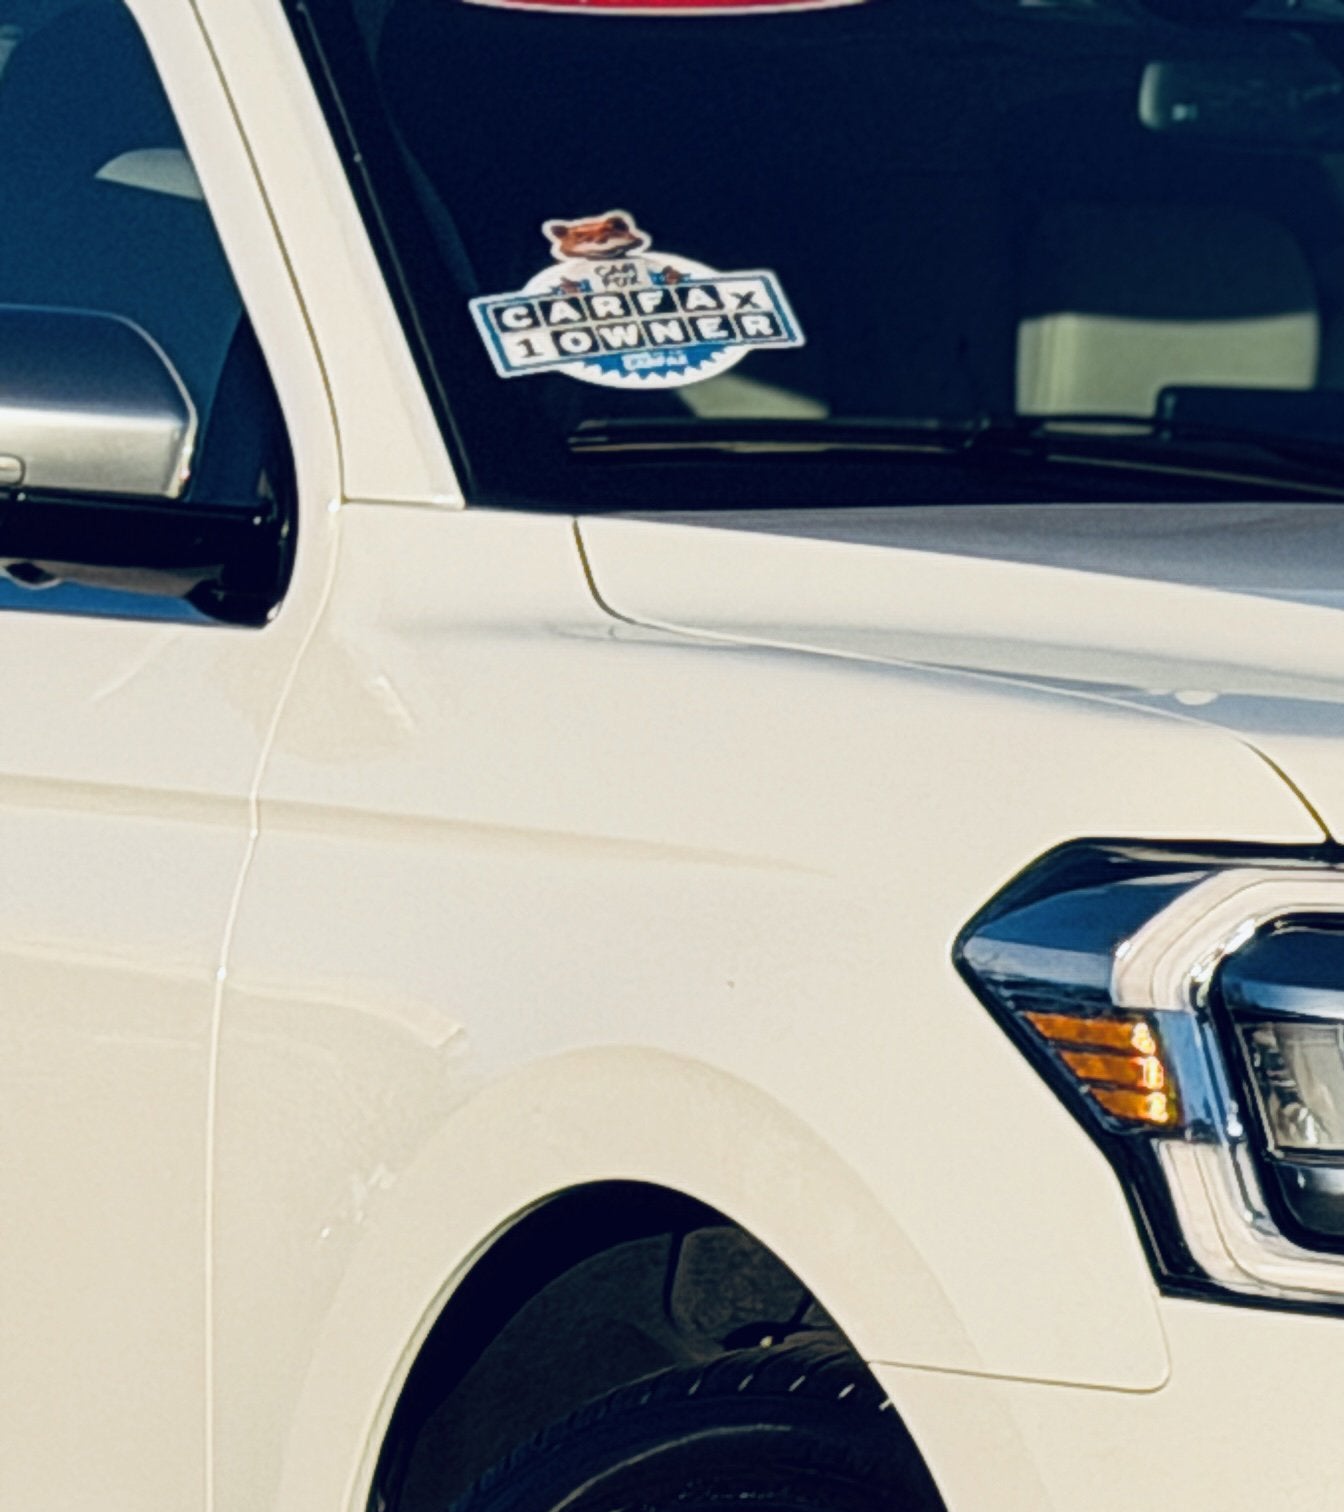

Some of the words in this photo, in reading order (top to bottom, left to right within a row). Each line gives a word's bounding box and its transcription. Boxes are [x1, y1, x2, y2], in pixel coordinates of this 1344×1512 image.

[501, 287, 764, 329] CARFAX
[516, 337, 543, 358] 1
[559, 315, 773, 351] OWNER
